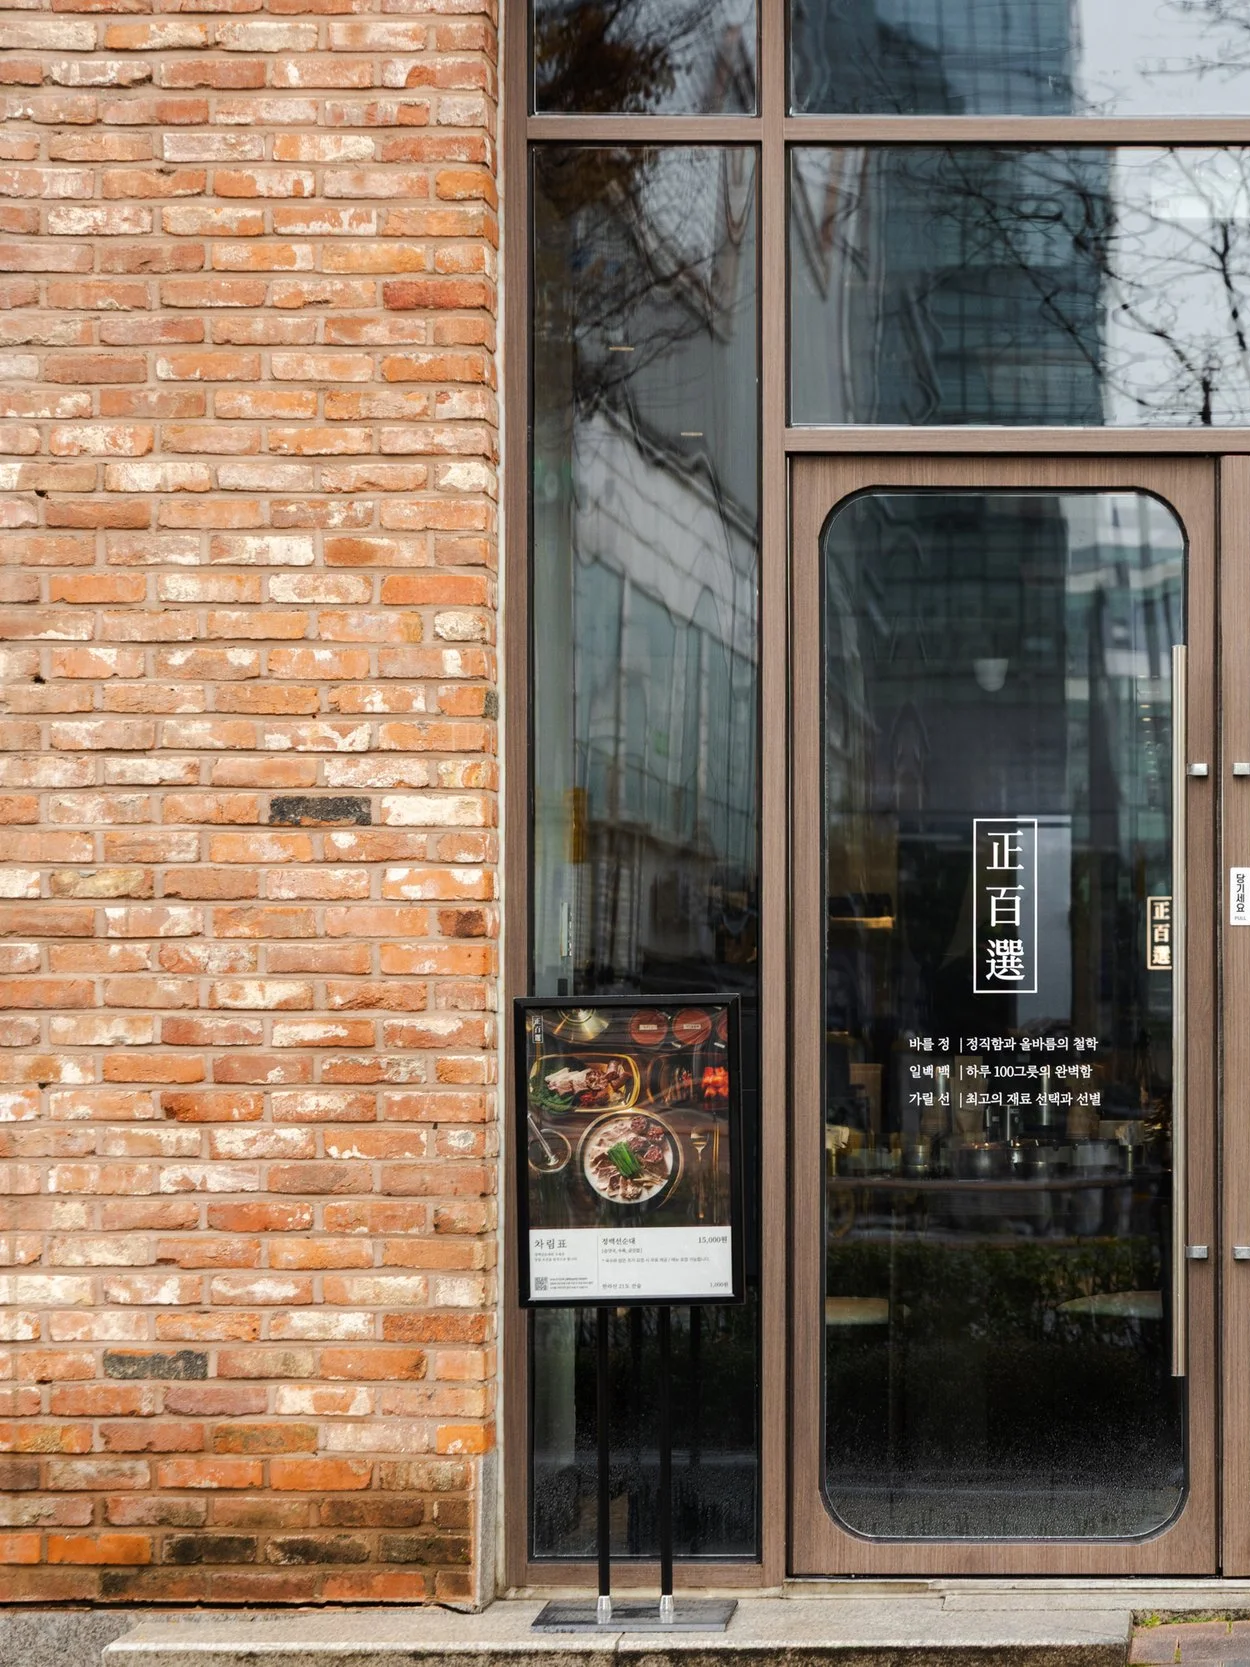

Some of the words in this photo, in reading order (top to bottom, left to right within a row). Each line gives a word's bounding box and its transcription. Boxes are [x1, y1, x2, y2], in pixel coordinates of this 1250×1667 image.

[1236, 874, 1245, 912] 당기세요
[986, 830, 1025, 981] 正百選
[909, 1037, 935, 1052] 바를
[938, 1037, 950, 1051] 정
[966, 1037, 1017, 1051] 정직함과
[1019, 1037, 1069, 1051] 올바름의
[1073, 1037, 1099, 1052] 철학
[909, 1065, 934, 1079] 일백
[937, 1065, 950, 1079] 백
[965, 1065, 992, 1079] 하루
[994, 1065, 1050, 1079] 100그릇의
[1054, 1065, 1093, 1079] 완벽함
[909, 1092, 934, 1106] 가릴
[938, 1092, 950, 1106] 선
[965, 1092, 1003, 1107] 최고의
[1006, 1092, 1033, 1107] 재료
[1036, 1092, 1073, 1106] 선택과
[1076, 1092, 1101, 1106] 선별
